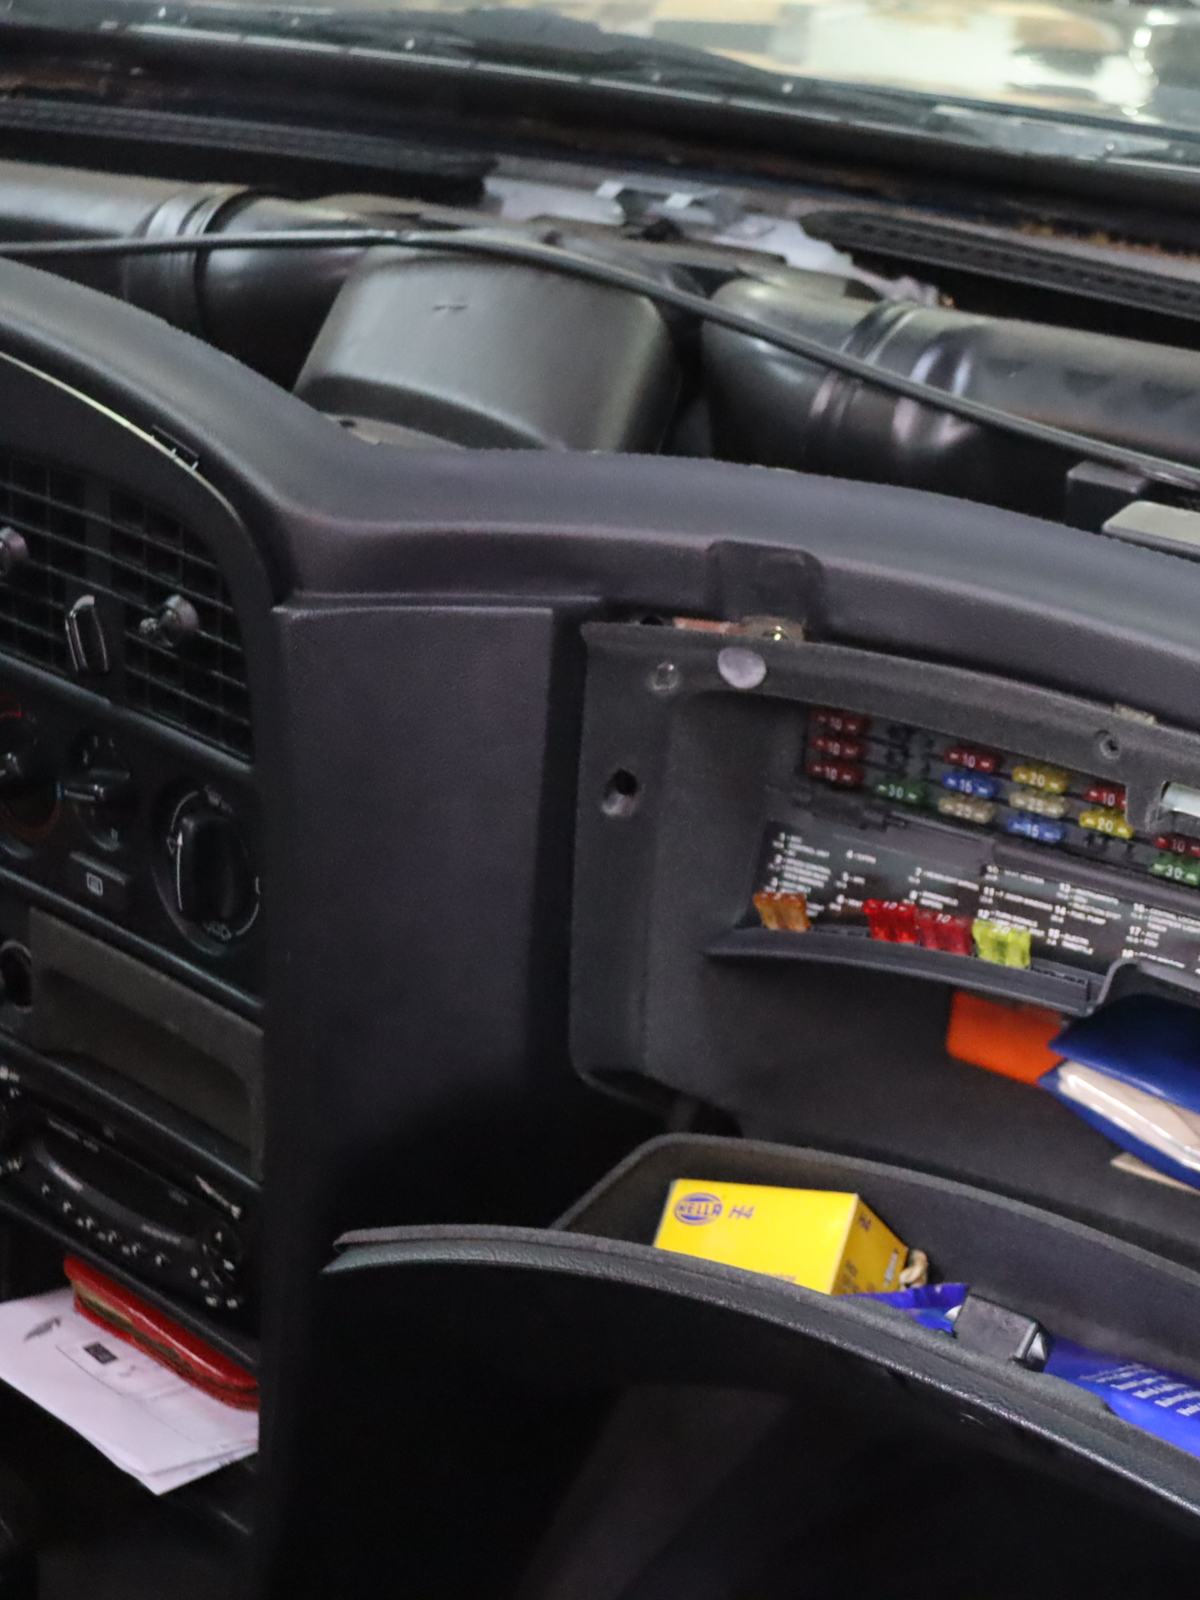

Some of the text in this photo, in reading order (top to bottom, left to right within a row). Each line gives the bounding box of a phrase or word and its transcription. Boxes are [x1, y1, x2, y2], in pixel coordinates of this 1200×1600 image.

[961, 753, 976, 768] 10
[1029, 772, 1046, 787] 20
[888, 784, 904, 799] 30
[1102, 791, 1116, 807] 10
[1097, 818, 1114, 833] 20
[1172, 839, 1185, 852] 10
[1166, 865, 1183, 879] 30
[882, 901, 898, 910] 10
[935, 913, 951, 924] 10
[728, 1204, 756, 1220] H4
